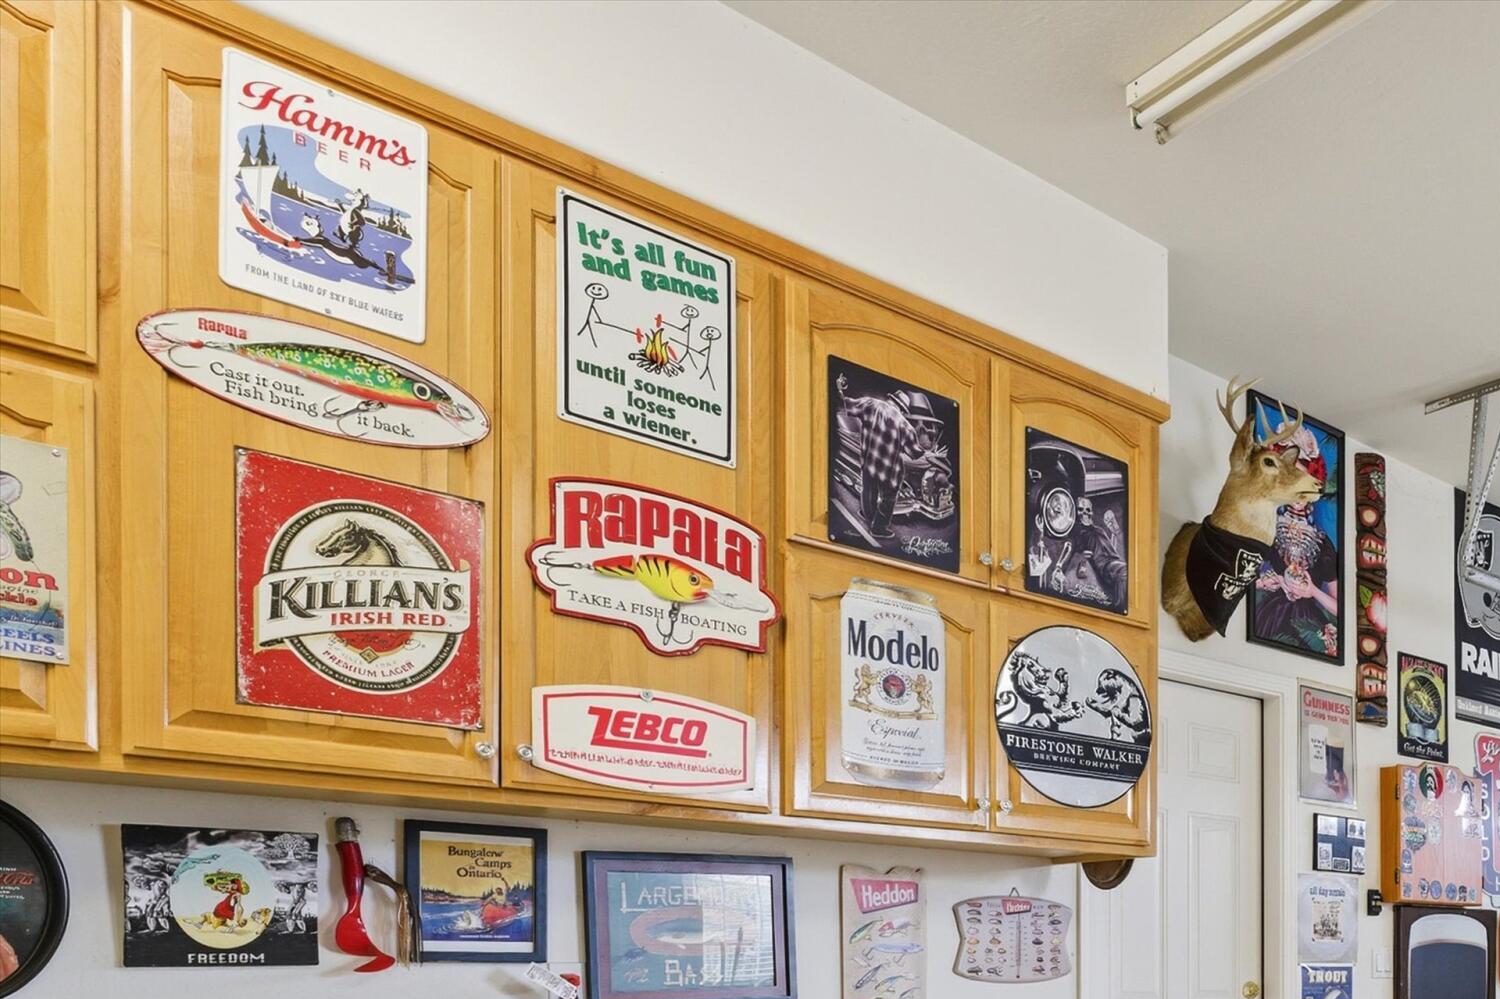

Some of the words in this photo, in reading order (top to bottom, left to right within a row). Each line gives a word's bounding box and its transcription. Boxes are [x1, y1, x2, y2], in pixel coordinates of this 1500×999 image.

[238, 81, 416, 167] Hamm's
[292, 132, 373, 172] BEER
[576, 221, 624, 256] It's
[634, 241, 665, 267] all
[673, 249, 717, 282] fun
[245, 263, 271, 281] FROM
[273, 272, 289, 285] THE
[292, 278, 314, 295] LAND
[317, 285, 327, 298] OF
[348, 296, 370, 312] BLUE
[372, 303, 404, 322] WATERS
[581, 251, 632, 282] and
[640, 269, 720, 304] games
[209, 361, 252, 387] Cast
[255, 372, 269, 388] it
[272, 380, 305, 397] out.
[576, 359, 626, 387] until
[634, 379, 722, 416] someone
[224, 380, 264, 403] Fish
[269, 388, 318, 418] bring
[627, 390, 676, 420] loses
[357, 412, 370, 428] it
[373, 416, 415, 439] back.
[603, 406, 615, 420] a
[622, 410, 697, 445] wiener.
[268, 576, 464, 621] KILLIAN'S
[566, 589, 613, 609] TAKE
[615, 600, 627, 612] A
[631, 603, 665, 620] FISH
[680, 613, 748, 637] BOATING
[330, 611, 392, 627] IRISH
[402, 613, 446, 627] RED
[848, 618, 940, 672] Modelo
[322, 650, 378, 678] PREMIUM
[381, 661, 415, 678] LAGER
[1303, 690, 1350, 716] GUINNESS
[588, 706, 708, 759] ZEBCO
[1006, 734, 1085, 757] FIRESTONE
[1092, 746, 1144, 765] WALKER
[448, 846, 505, 858] Bungalow
[475, 858, 512, 870] Camps
[457, 867, 502, 878] Ontario
[861, 884, 915, 909] Heddon
[188, 953, 265, 964] FREEDOM
[1309, 970, 1347, 984] TROUT
